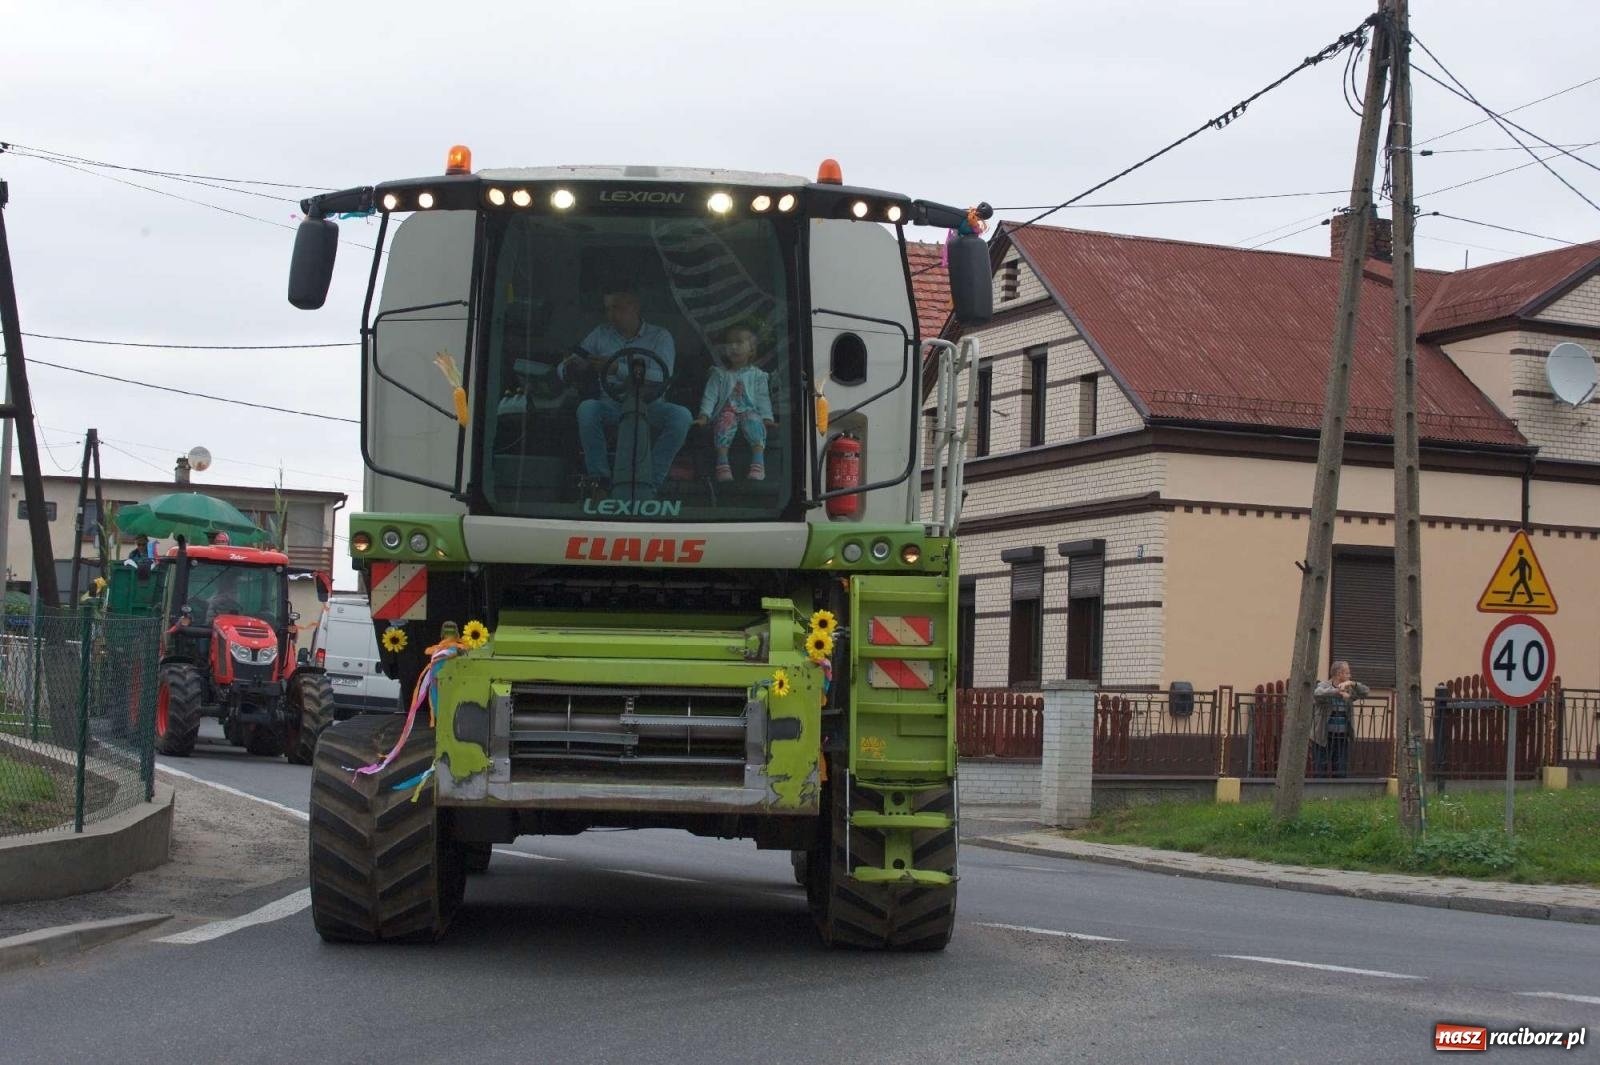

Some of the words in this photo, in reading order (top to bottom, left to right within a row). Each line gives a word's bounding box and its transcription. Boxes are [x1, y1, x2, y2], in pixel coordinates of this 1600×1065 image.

[600, 190, 685, 204] LEXION
[583, 498, 682, 516] LEXION
[565, 536, 706, 563] CLAAS
[1493, 639, 1545, 681] 40
